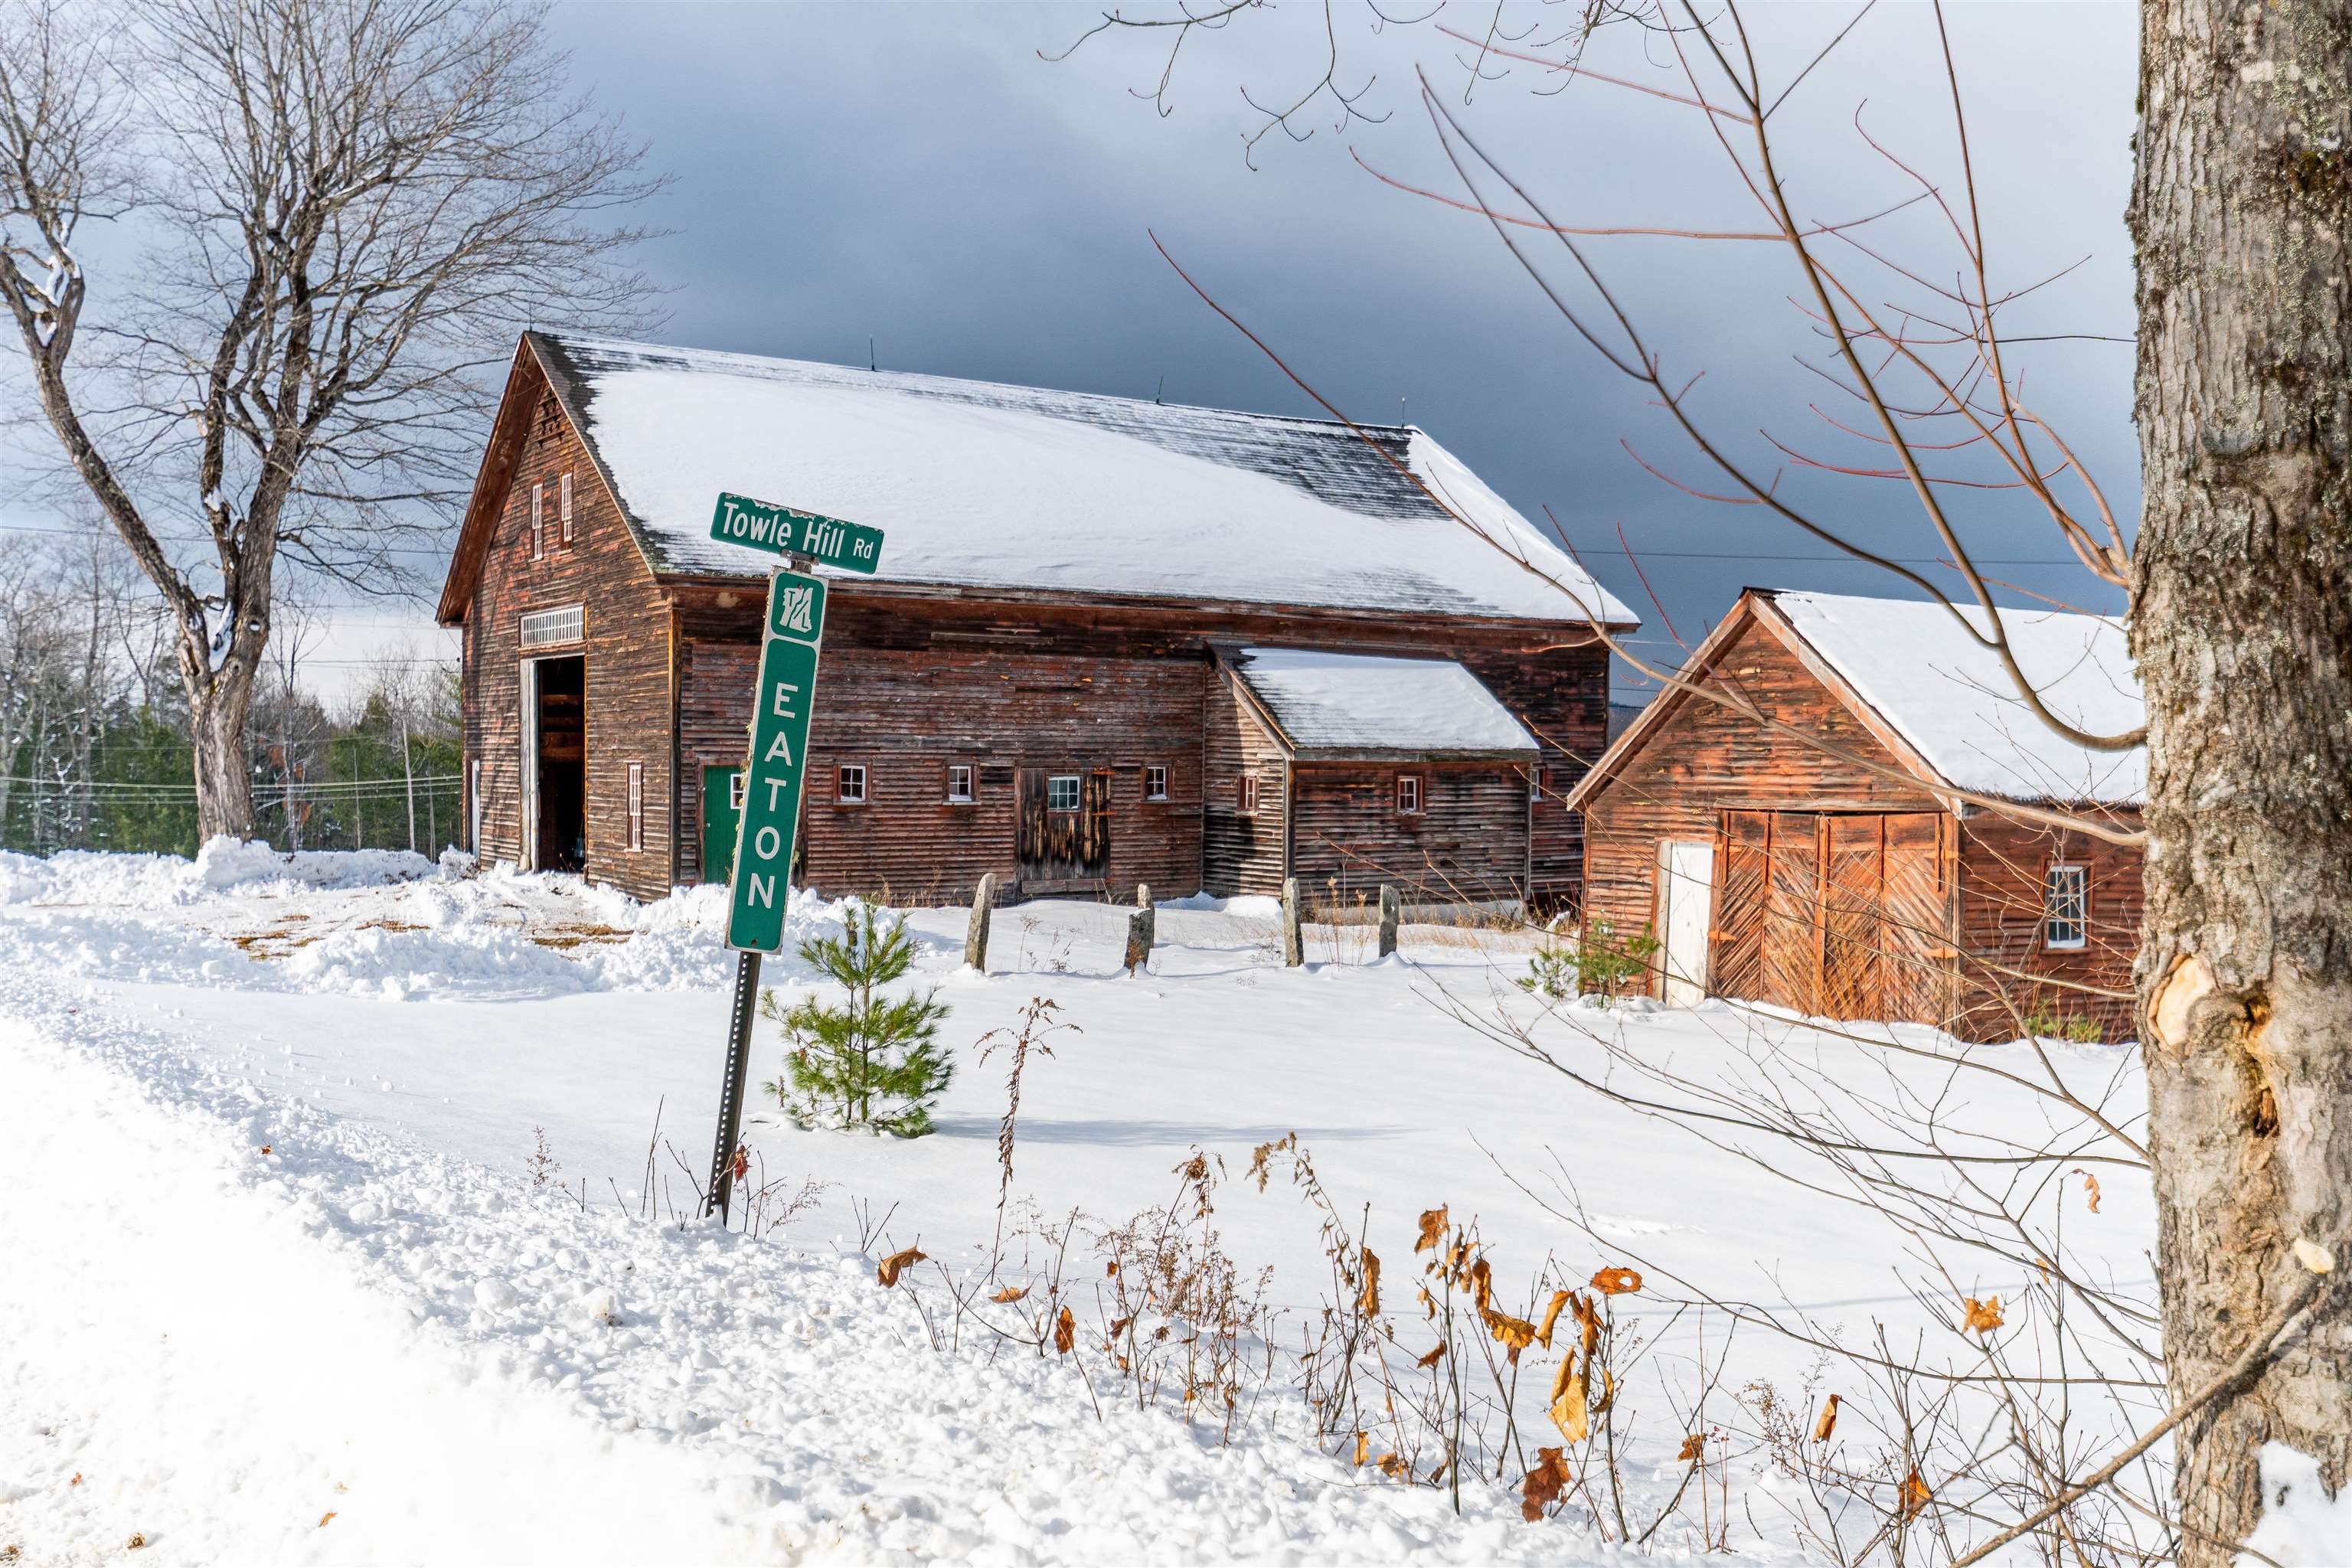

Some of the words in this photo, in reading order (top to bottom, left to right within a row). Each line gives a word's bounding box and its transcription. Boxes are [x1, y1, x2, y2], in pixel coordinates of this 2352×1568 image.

[723, 502, 792, 547] Towle
[802, 521, 845, 558] Hill
[853, 538, 874, 560] Rd
[747, 682, 799, 910] EATON
